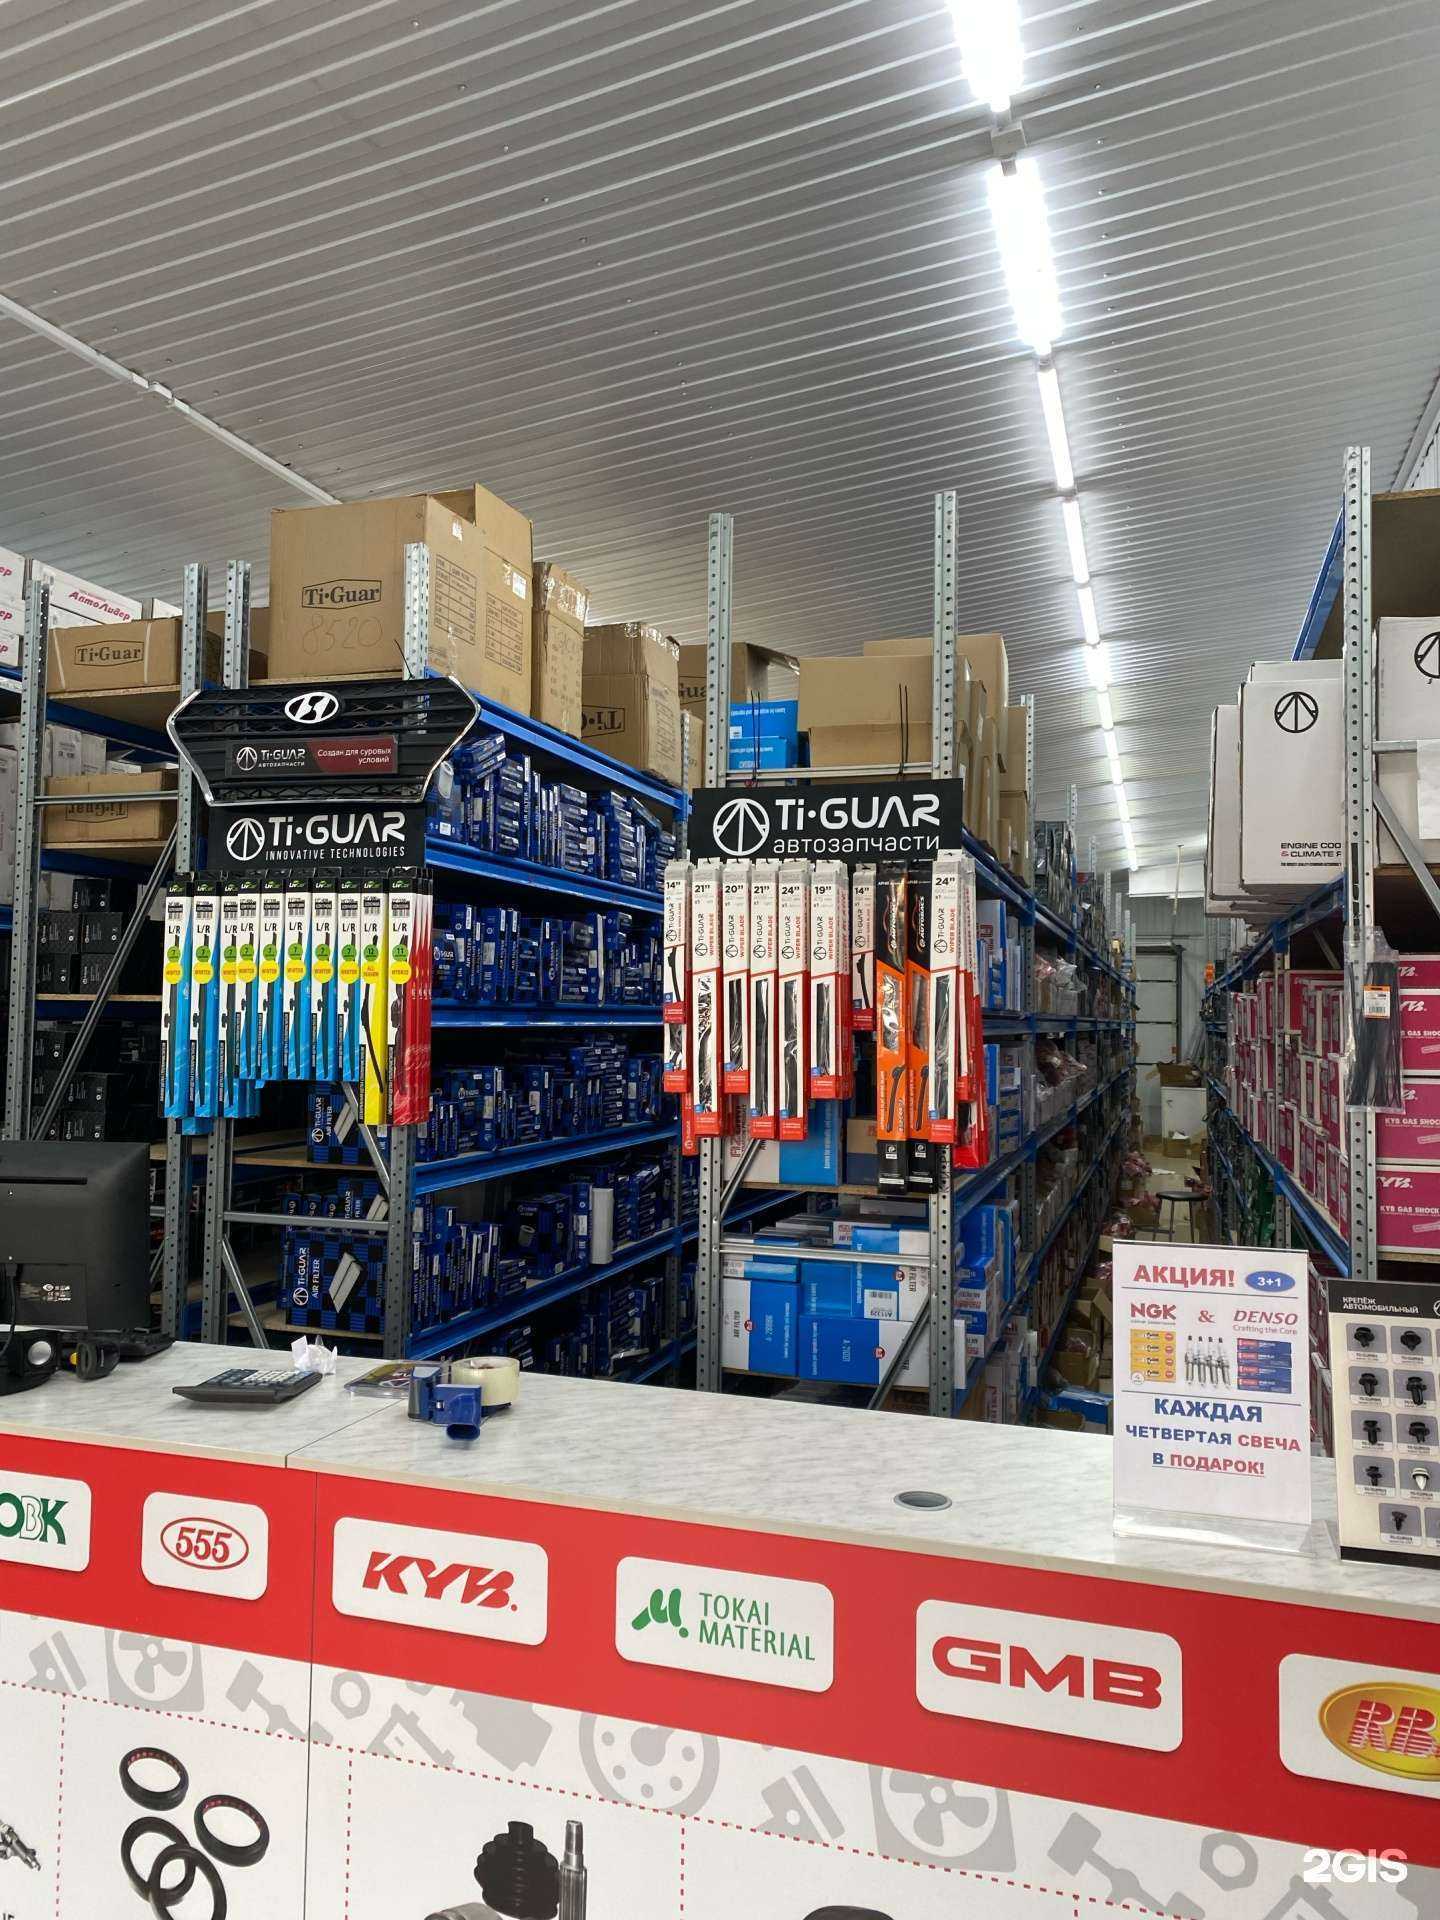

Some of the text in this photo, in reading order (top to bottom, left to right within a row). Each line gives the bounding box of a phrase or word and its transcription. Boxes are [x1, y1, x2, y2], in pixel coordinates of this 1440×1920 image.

[303, 613, 384, 656] 8520
[317, 748, 392, 758] Создан для суровых
[358, 756, 390, 765] условий
[773, 835, 940, 854] автозапчасти
[265, 846, 406, 861] INNOVATIVE TECHNOLOGIES
[1290, 850, 1335, 858] CLIMATE
[168, 925, 181, 934] L/R
[197, 925, 210, 934] L/R
[224, 925, 237, 934] L/R
[240, 923, 254, 932] L/R
[264, 923, 277, 931] L/R
[289, 922, 303, 931] L/R
[316, 922, 330, 931] L/R
[342, 923, 356, 932] L/R
[364, 923, 378, 932] L/R
[392, 923, 407, 932] L/R
[312, 1259, 320, 1283] FILTER
[1133, 1264, 1235, 1288] АКЦИЯ!
[908, 1273, 917, 1292] FILTER
[1257, 1276, 1282, 1287] 3+1
[1342, 1296, 1376, 1304] КРЕПЁЖ
[1130, 1303, 1177, 1320] NGK
[1343, 1303, 1419, 1314] АВТОМОБИЛЬНЫЙ
[1198, 1310, 1215, 1323] &
[1233, 1309, 1298, 1326] DENSO
[1232, 1324, 1265, 1334] Crafting
[1279, 1327, 1298, 1335] Core
[1154, 1398, 1263, 1423] КАЖДАЯ
[1125, 1424, 1301, 1452] ЧЕТВЕРТАЯ СВЕЧА
[1152, 1452, 1265, 1475] В ПОДАРОК!
[175, 1526, 232, 1563] 555
[699, 1591, 770, 1627] TOKAI
[699, 1622, 816, 1661] MATERIAL
[932, 1635, 1162, 1710] GMB
